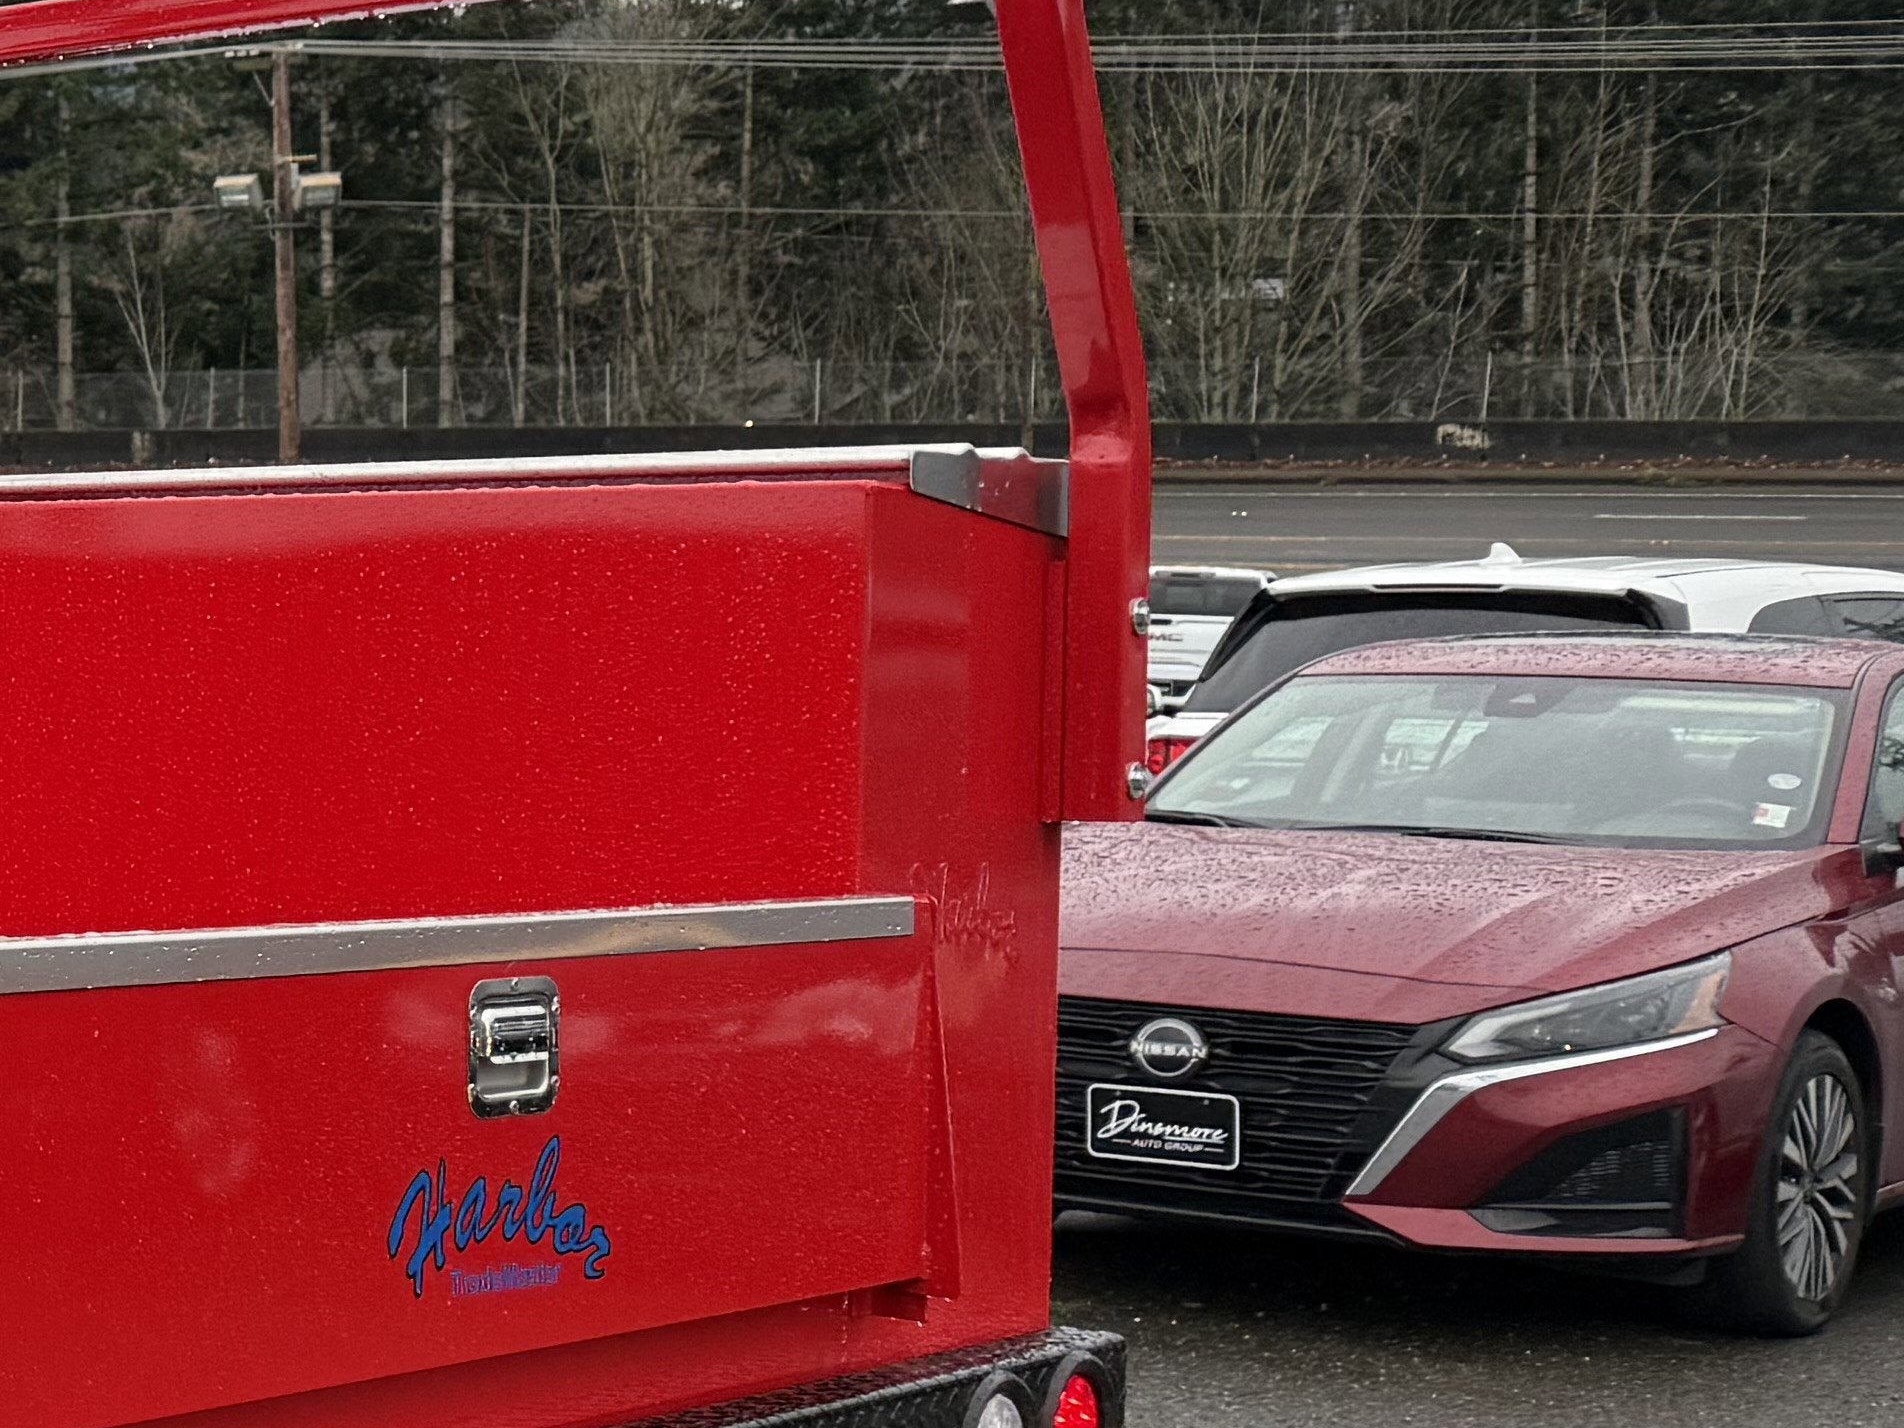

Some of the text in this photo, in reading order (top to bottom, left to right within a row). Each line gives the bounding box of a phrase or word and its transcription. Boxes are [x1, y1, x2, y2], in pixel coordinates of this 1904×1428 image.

[1130, 1040, 1208, 1059] NISSAN
[1097, 1100, 1229, 1139] Dinsmore
[1131, 1138, 1205, 1153] AUTO GROUP
[388, 1134, 611, 1299] Harbor
